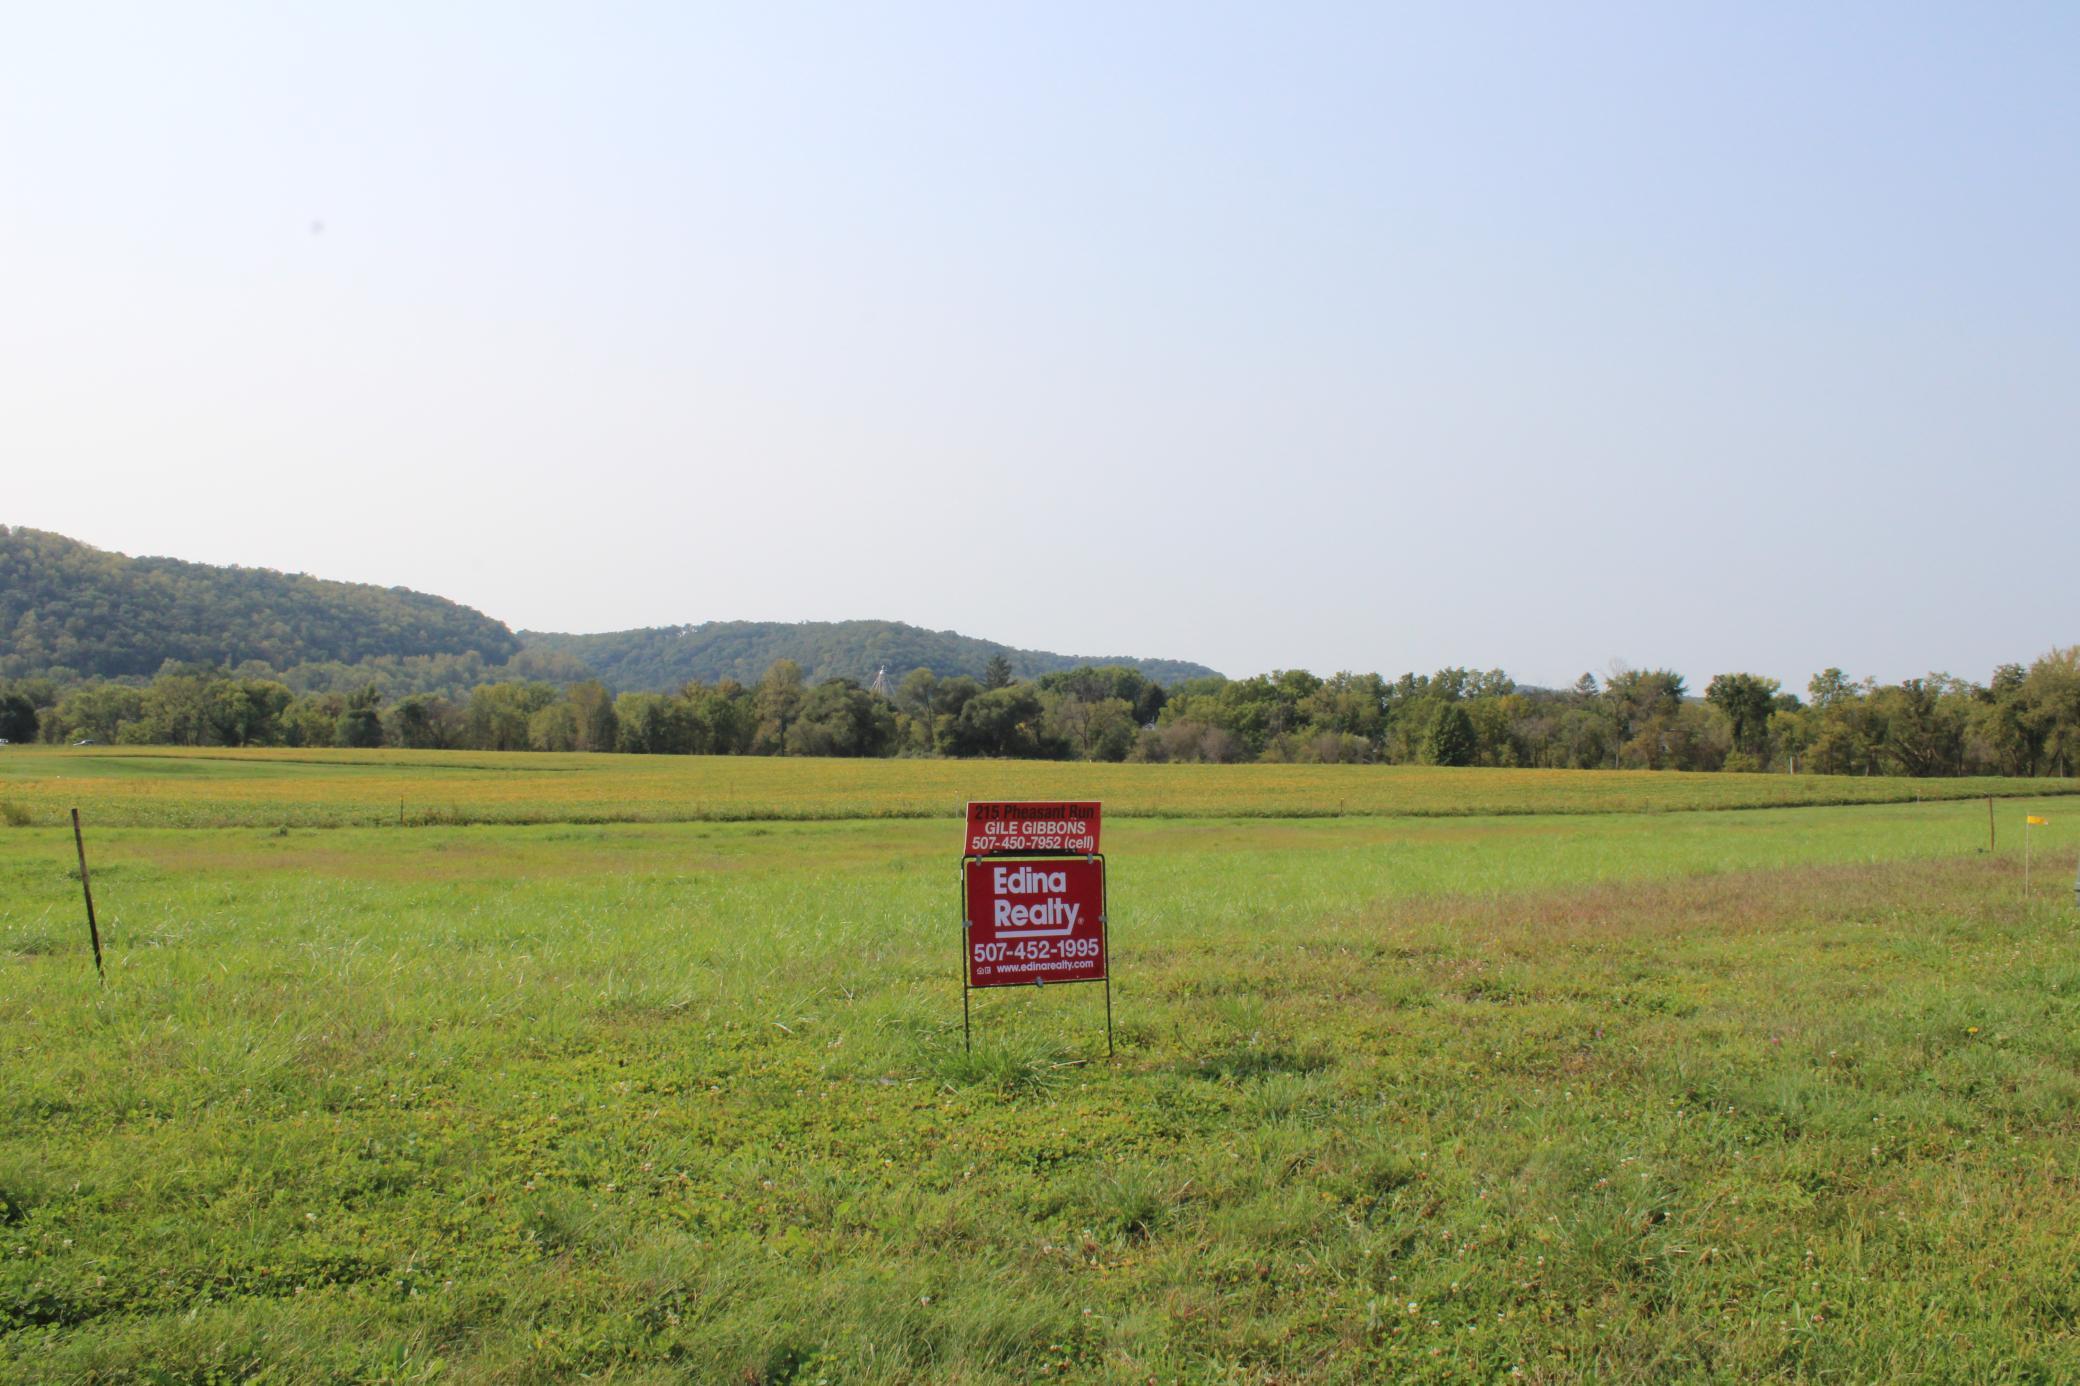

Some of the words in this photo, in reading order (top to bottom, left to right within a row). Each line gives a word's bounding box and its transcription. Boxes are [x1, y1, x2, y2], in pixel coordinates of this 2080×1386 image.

[975, 804, 1000, 819] 215
[1004, 804, 1065, 819] Pheasant
[1069, 804, 1094, 819] Run
[985, 821, 1018, 835] GILE
[1022, 821, 1086, 835] GIBBONS
[972, 836, 1061, 850] 507-450-7952
[1064, 835, 1094, 851] (cell)
[994, 866, 1067, 894] Edina
[994, 898, 1080, 936] Realty
[974, 938, 1099, 962] 507-452-1995
[997, 960, 1094, 973] www.edinarealty.com
